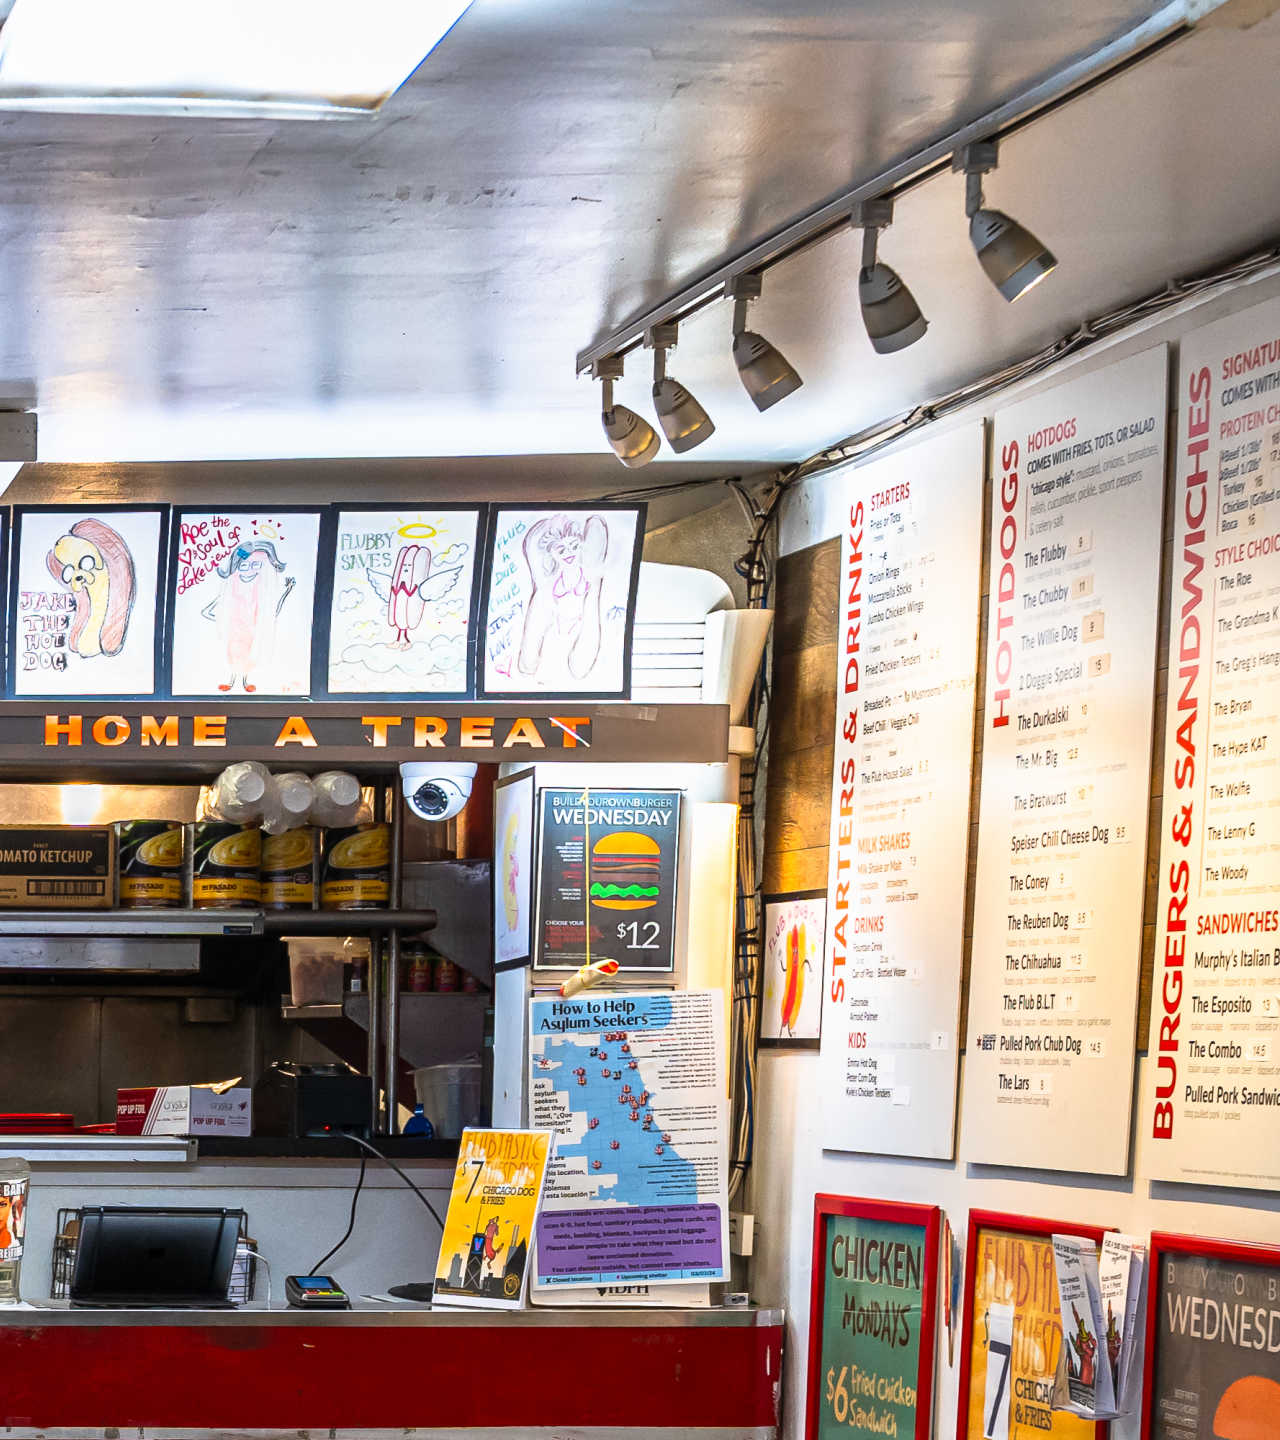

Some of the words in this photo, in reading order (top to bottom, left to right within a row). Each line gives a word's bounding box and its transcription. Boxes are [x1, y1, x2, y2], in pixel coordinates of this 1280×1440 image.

[1220, 384, 1249, 407] COMES
[1027, 417, 1077, 454] HOTDOGS
[1220, 413, 1264, 440] PROTEIN
[1026, 453, 1050, 475] COMES
[1051, 447, 1072, 469] WITH
[1116, 429, 1128, 446] OR
[1129, 417, 1155, 444] SALAD
[870, 481, 910, 511] STARTERS
[211, 516, 230, 528] the
[1024, 549, 1038, 569] The
[1040, 543, 1067, 567] Flubby
[1215, 543, 1246, 569] STYLE
[993, 439, 1019, 728] HOTDOGS
[1174, 365, 1211, 789] SANDWICHES
[20, 591, 77, 612] JAKE
[844, 500, 863, 693] DRINKS
[1038, 586, 1069, 610] Chubby
[23, 614, 70, 632] THE
[1060, 623, 1078, 645] Dog
[24, 633, 67, 651] HOT
[23, 651, 67, 673] DOG
[42, 714, 228, 747] HOME
[273, 716, 317, 747] A
[360, 715, 589, 747] TREAT
[843, 707, 858, 743] &
[1017, 714, 1030, 731] The
[1032, 707, 1068, 730] Durkalski
[1044, 750, 1058, 772] Big
[553, 808, 673, 827] WEDNESDAY
[1172, 802, 1193, 848] &
[857, 836, 877, 854] MILK
[878, 831, 911, 852] SHAKES
[1011, 833, 1039, 853] Speiser
[1041, 830, 1058, 849] Chili
[1061, 828, 1090, 848] Cheese
[1092, 825, 1109, 847] Dog
[40, 850, 93, 864] KETCHUP
[832, 757, 854, 1003] STARTERS
[1010, 875, 1024, 891] The
[1025, 873, 1049, 893] Coney
[854, 916, 884, 934] DRINKS
[1008, 915, 1021, 932] The
[1023, 913, 1050, 931] Reuben
[1052, 912, 1069, 932] Dog
[1197, 910, 1279, 936] SANDWICHES
[617, 921, 660, 949] $12
[1006, 955, 1019, 971] The
[1021, 953, 1061, 970] Chihuahua
[1195, 950, 1237, 971] Murphy's
[1240, 948, 1270, 967] Italian
[552, 1001, 582, 1017] How
[587, 1001, 600, 1014] to
[603, 1000, 636, 1015] Help
[1004, 995, 1017, 1011] The
[1018, 993, 1035, 1010] Flub
[1153, 862, 1190, 1140] BURGERS
[1192, 995, 1208, 1013] The
[1210, 994, 1252, 1016] Esposito
[541, 1016, 590, 1032] Asylum
[595, 1014, 649, 1029] Seekers
[848, 1031, 867, 1050] KIDS
[1000, 1036, 1025, 1052] Pulled
[1026, 1036, 1044, 1052] Pork
[1046, 1036, 1063, 1052] Chub
[1065, 1037, 1082, 1055] Dog
[1188, 1040, 1205, 1058] The
[1208, 1041, 1242, 1059] Combo
[999, 1073, 1012, 1090] The
[1014, 1074, 1030, 1090] Lars
[1185, 1085, 1214, 1104] Pulled
[1216, 1086, 1239, 1105] Pork
[117, 1104, 127, 1115] POP
[128, 1104, 135, 1115] UP
[136, 1104, 146, 1114] FOIL
[482, 1186, 517, 1198] CHICAGO
[518, 1187, 536, 1198] DOG
[831, 1234, 922, 1291] CHICKEN
[842, 1292, 911, 1349] MONDAYS
[826, 1365, 849, 1423] $6
[851, 1365, 877, 1399] Fried
[877, 1377, 918, 1408] Chicken
[848, 1399, 898, 1439] Sandwich
[1025, 1405, 1053, 1431] FRIES
